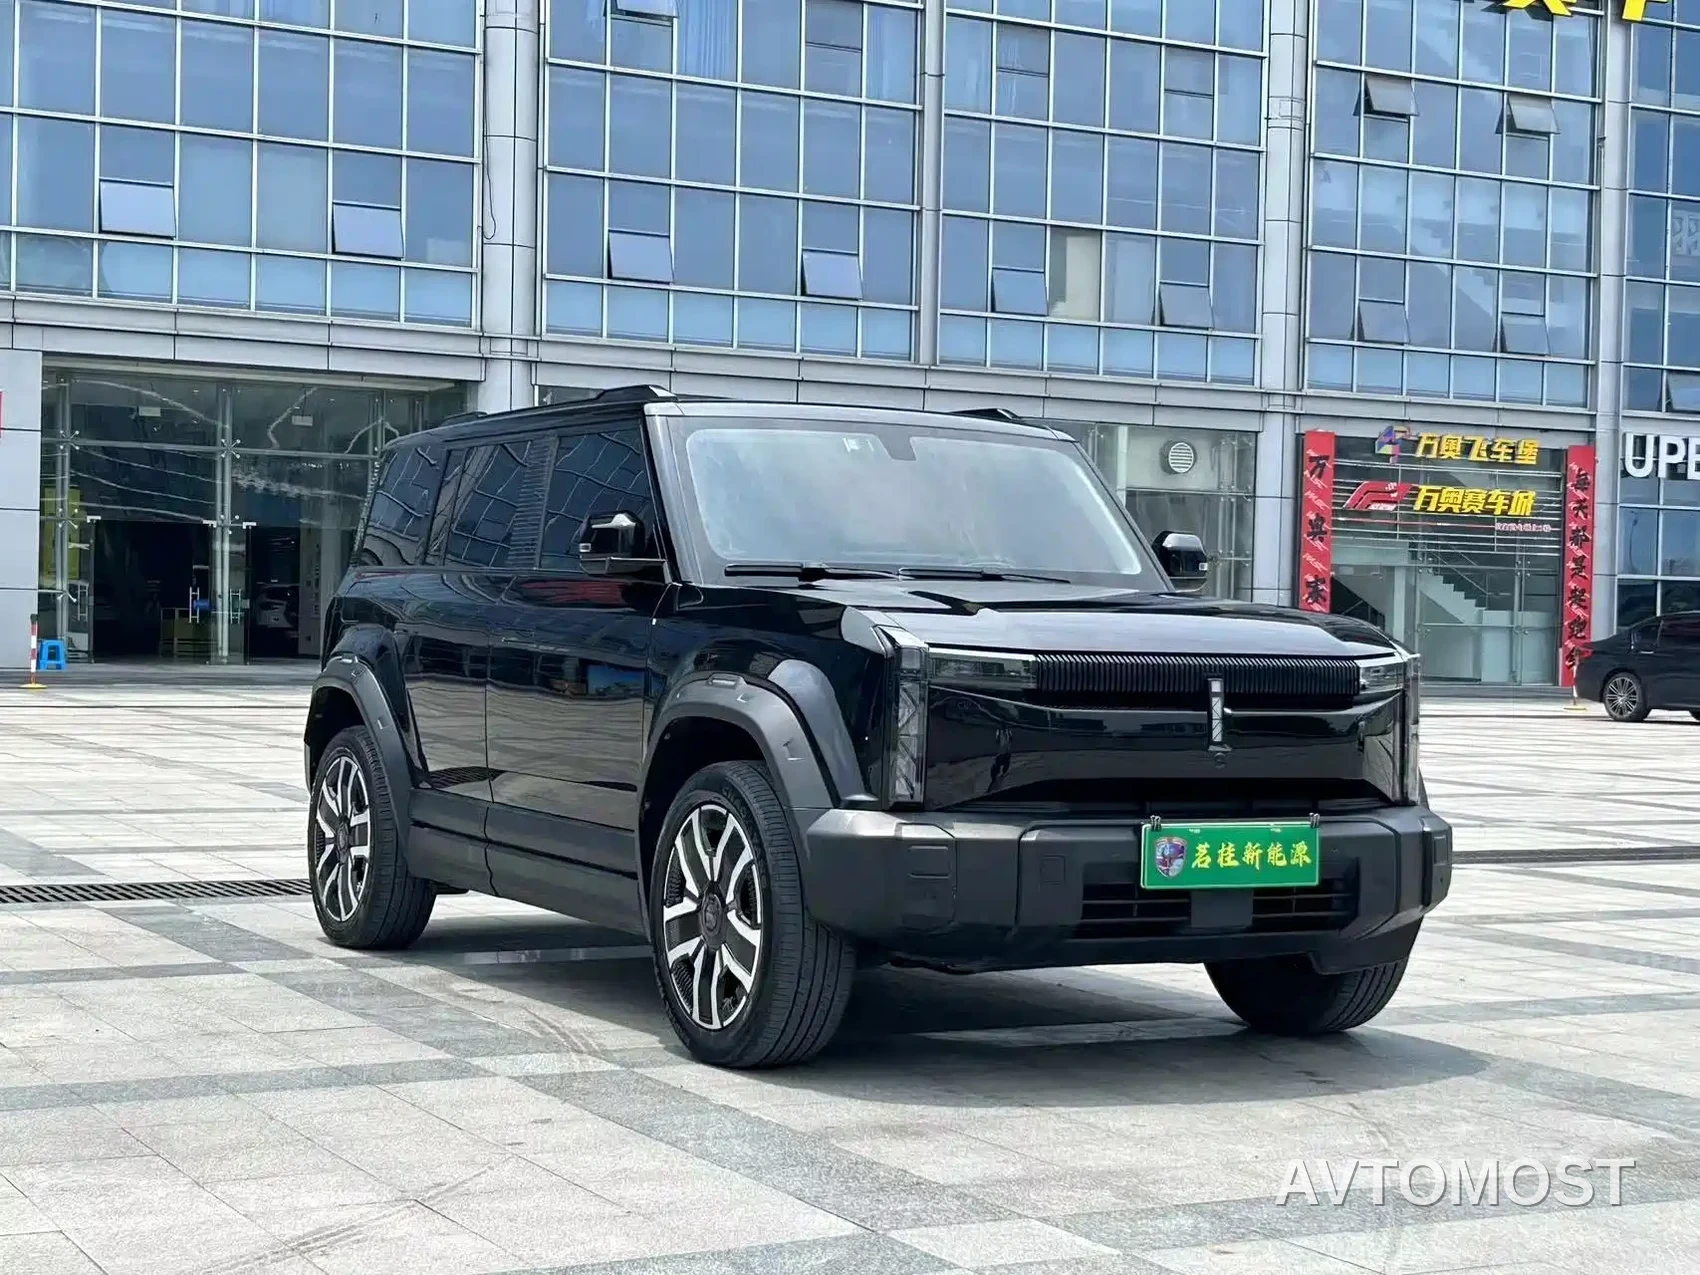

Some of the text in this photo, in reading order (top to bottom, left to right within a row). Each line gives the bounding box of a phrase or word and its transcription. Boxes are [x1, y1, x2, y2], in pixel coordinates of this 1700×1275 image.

[1415, 432, 1540, 465] 万奥飞车堡
[1412, 485, 1537, 516] 万奥赛车城
